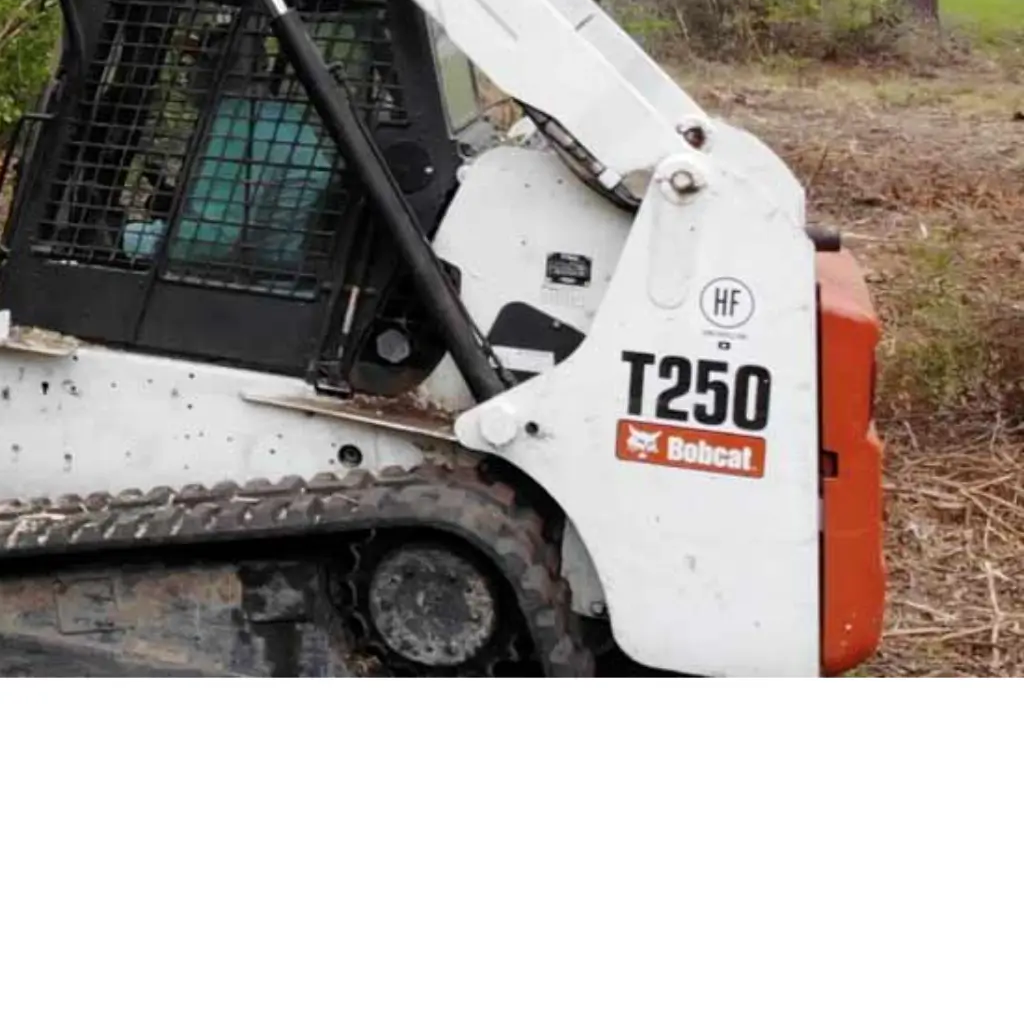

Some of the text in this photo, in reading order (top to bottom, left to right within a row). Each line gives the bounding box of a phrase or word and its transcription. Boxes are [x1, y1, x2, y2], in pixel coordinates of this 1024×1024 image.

[714, 287, 741, 317] HF
[621, 350, 772, 431] T250
[667, 436, 753, 471] Bobcat
